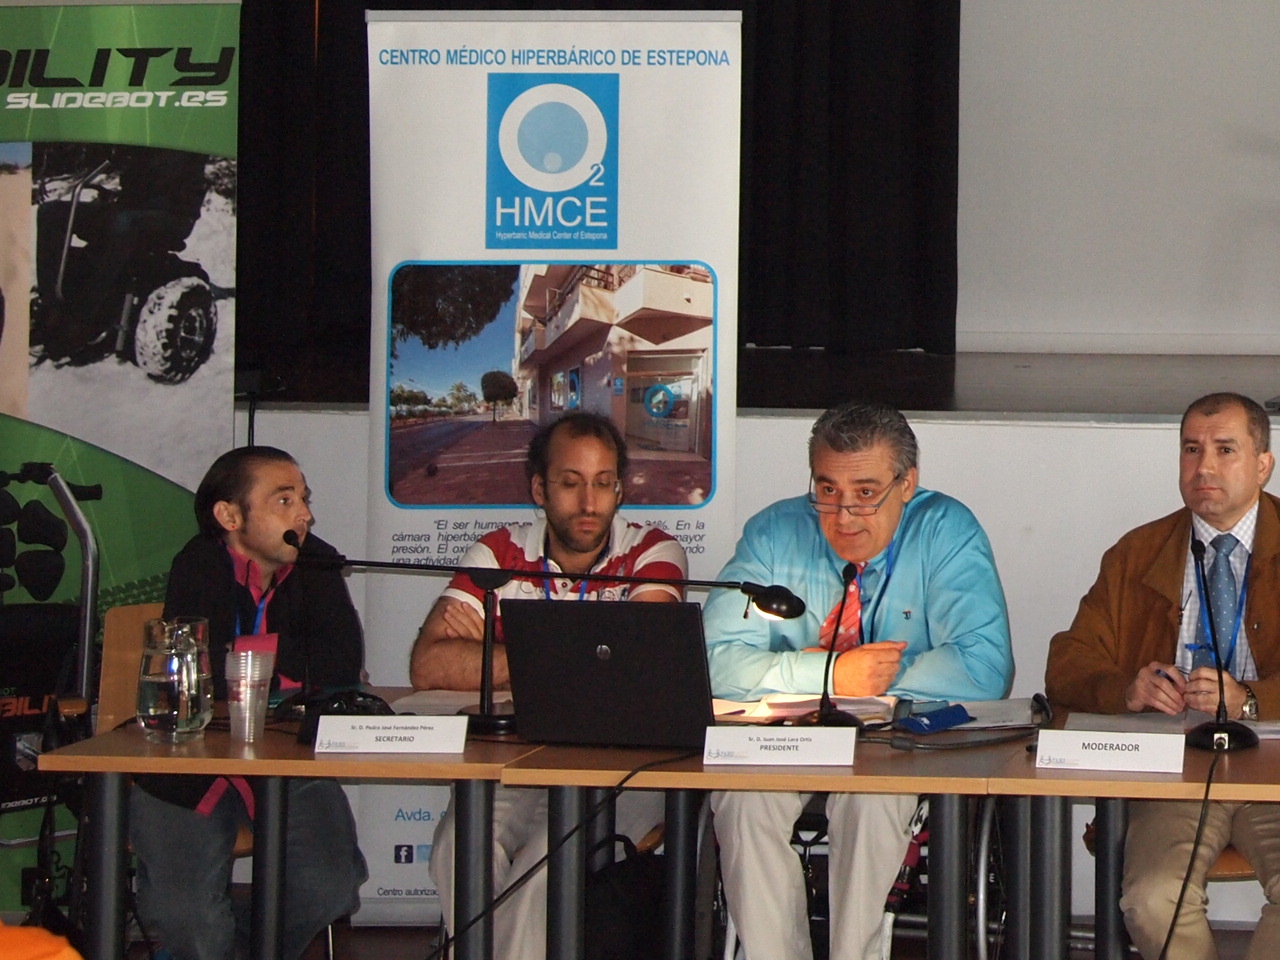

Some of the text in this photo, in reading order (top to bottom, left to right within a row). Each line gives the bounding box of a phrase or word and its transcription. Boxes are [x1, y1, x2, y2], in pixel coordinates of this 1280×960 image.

[379, 44, 730, 66] CENTRO MÉDICO HIPERBÁRICO DE ESTEPONA
[496, 196, 608, 227] HMCE
[528, 230, 551, 239] Medical
[552, 230, 572, 239] Center
[580, 230, 608, 241] Estepona
[452, 521, 468, 530] ser
[676, 520, 690, 530] En
[696, 520, 705, 530] la
[392, 532, 430, 542] cámara
[391, 543, 431, 555] presión.
[437, 543, 448, 554] El
[413, 555, 459, 566] actividad
[1081, 742, 1141, 752] MODERADOR
[394, 808, 434, 821] Avda.
[377, 888, 403, 896] Centro
